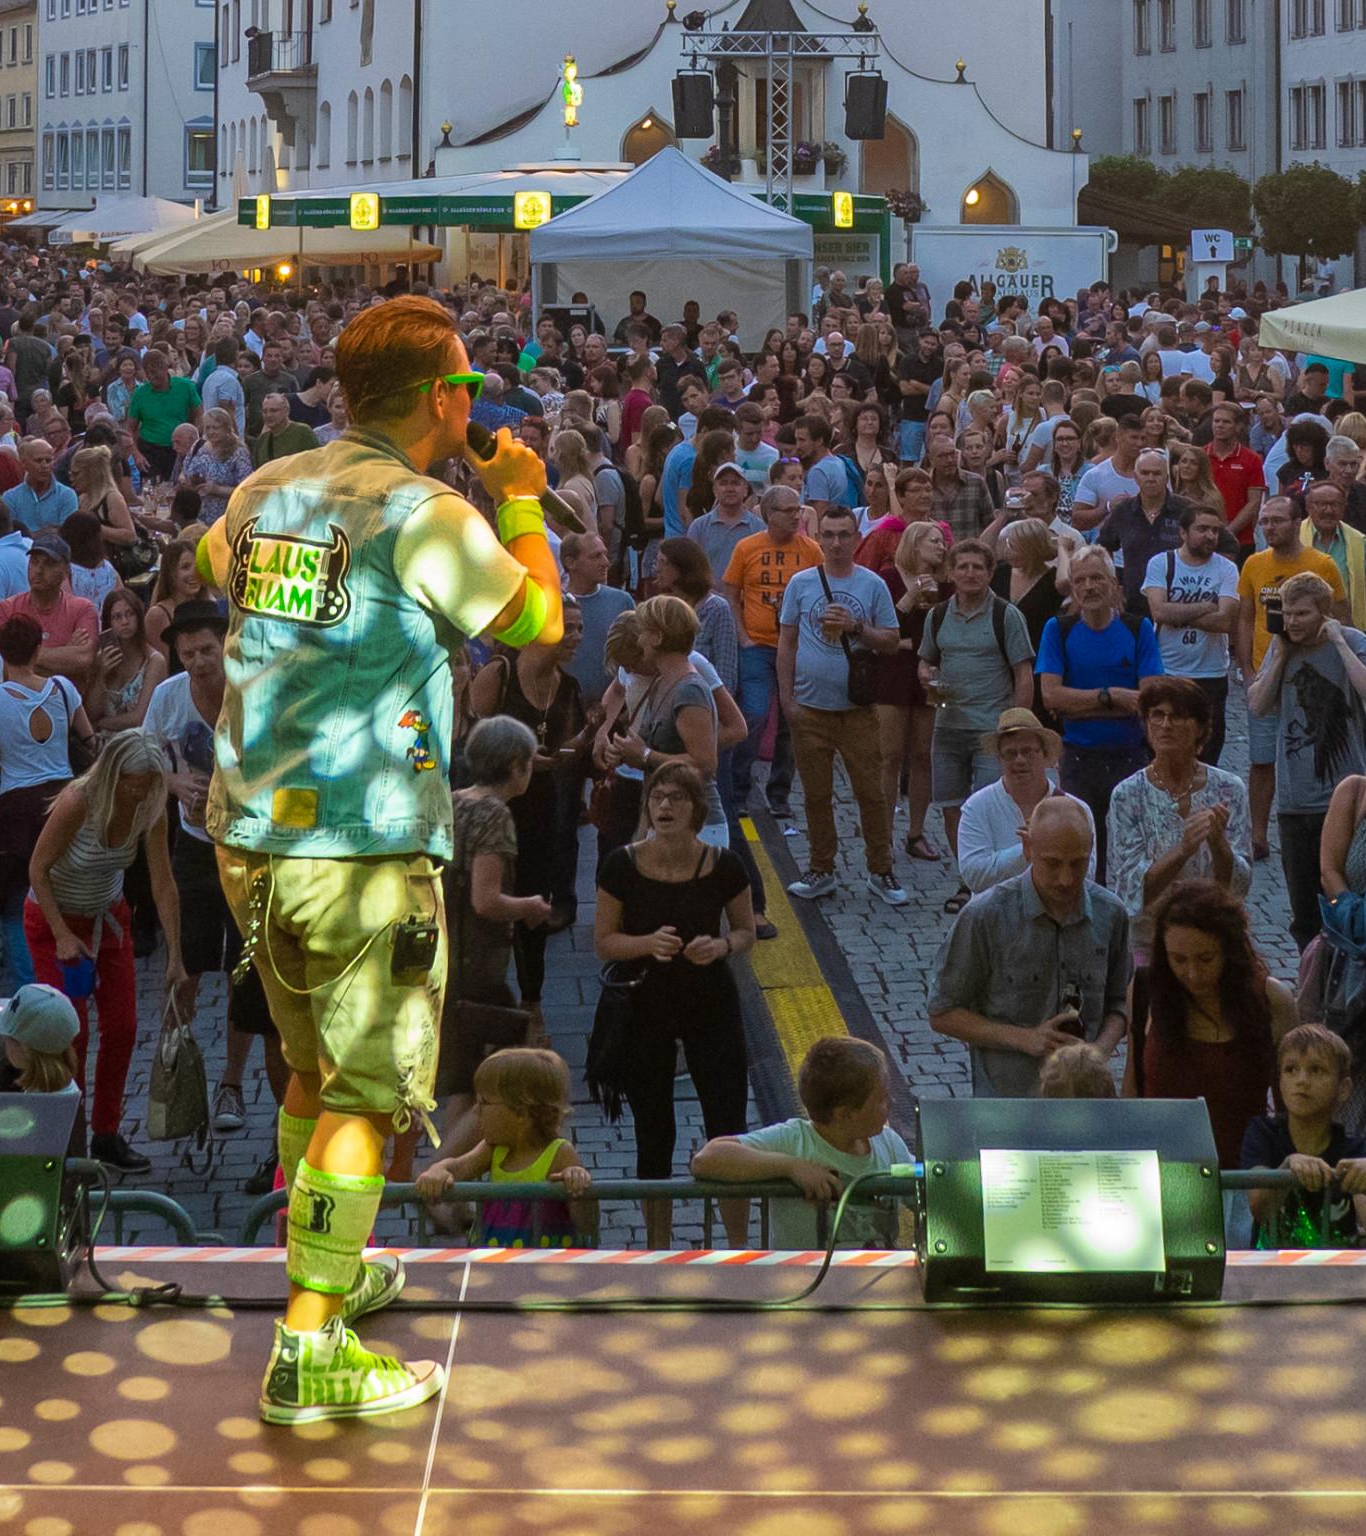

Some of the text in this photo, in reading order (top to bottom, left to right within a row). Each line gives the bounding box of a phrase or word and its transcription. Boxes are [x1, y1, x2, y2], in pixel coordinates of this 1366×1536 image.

[1204, 233, 1221, 243] WC
[250, 541, 320, 583] LAUS
[245, 577, 313, 618] BUAM
